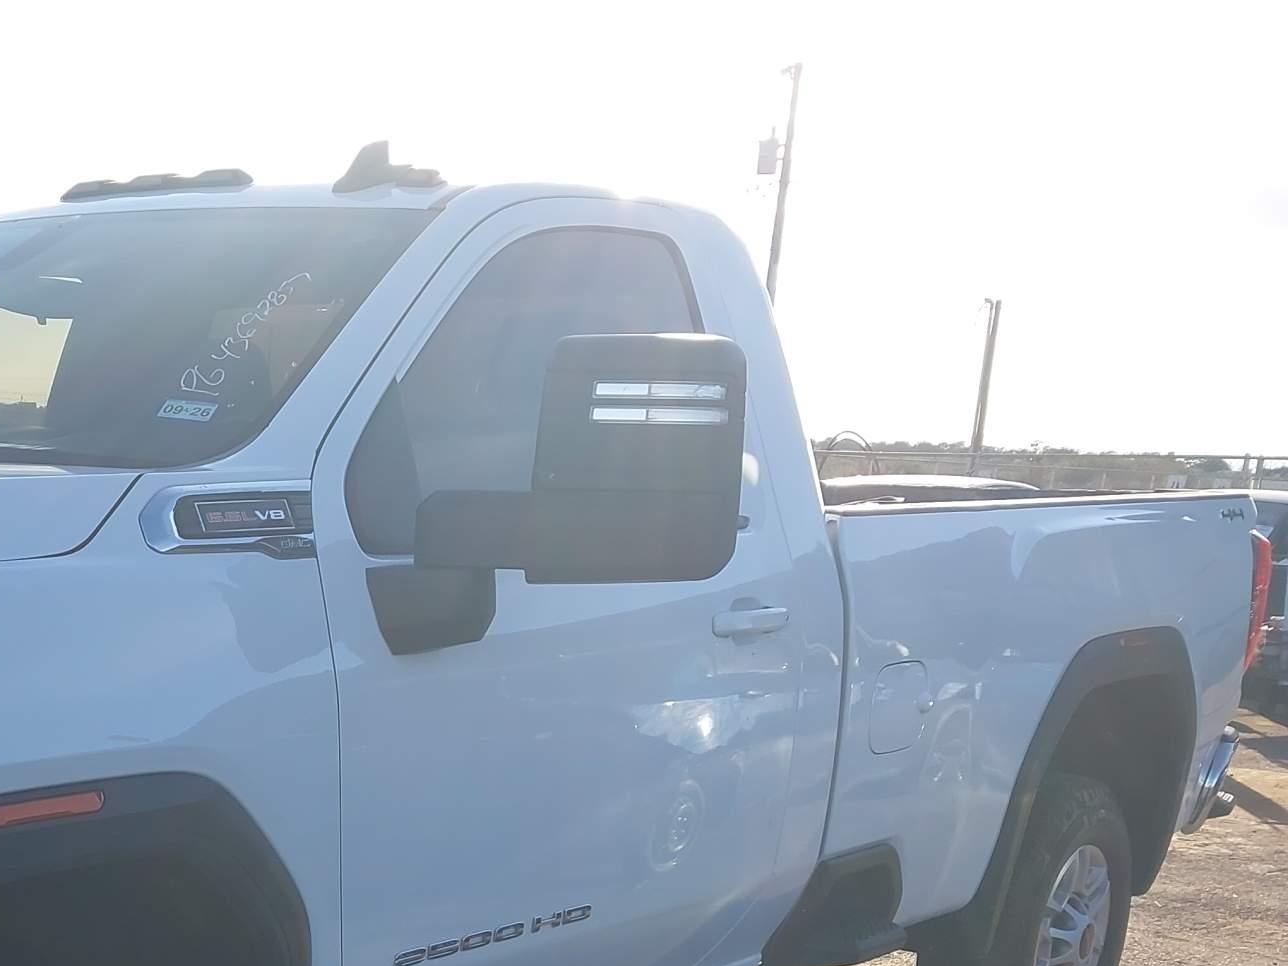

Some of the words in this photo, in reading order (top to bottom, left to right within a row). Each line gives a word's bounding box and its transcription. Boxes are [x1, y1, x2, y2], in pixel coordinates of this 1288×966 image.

[162, 403, 184, 416] 09
[190, 406, 212, 418] 26
[254, 509, 286, 522] V8
[530, 903, 593, 934] HD
